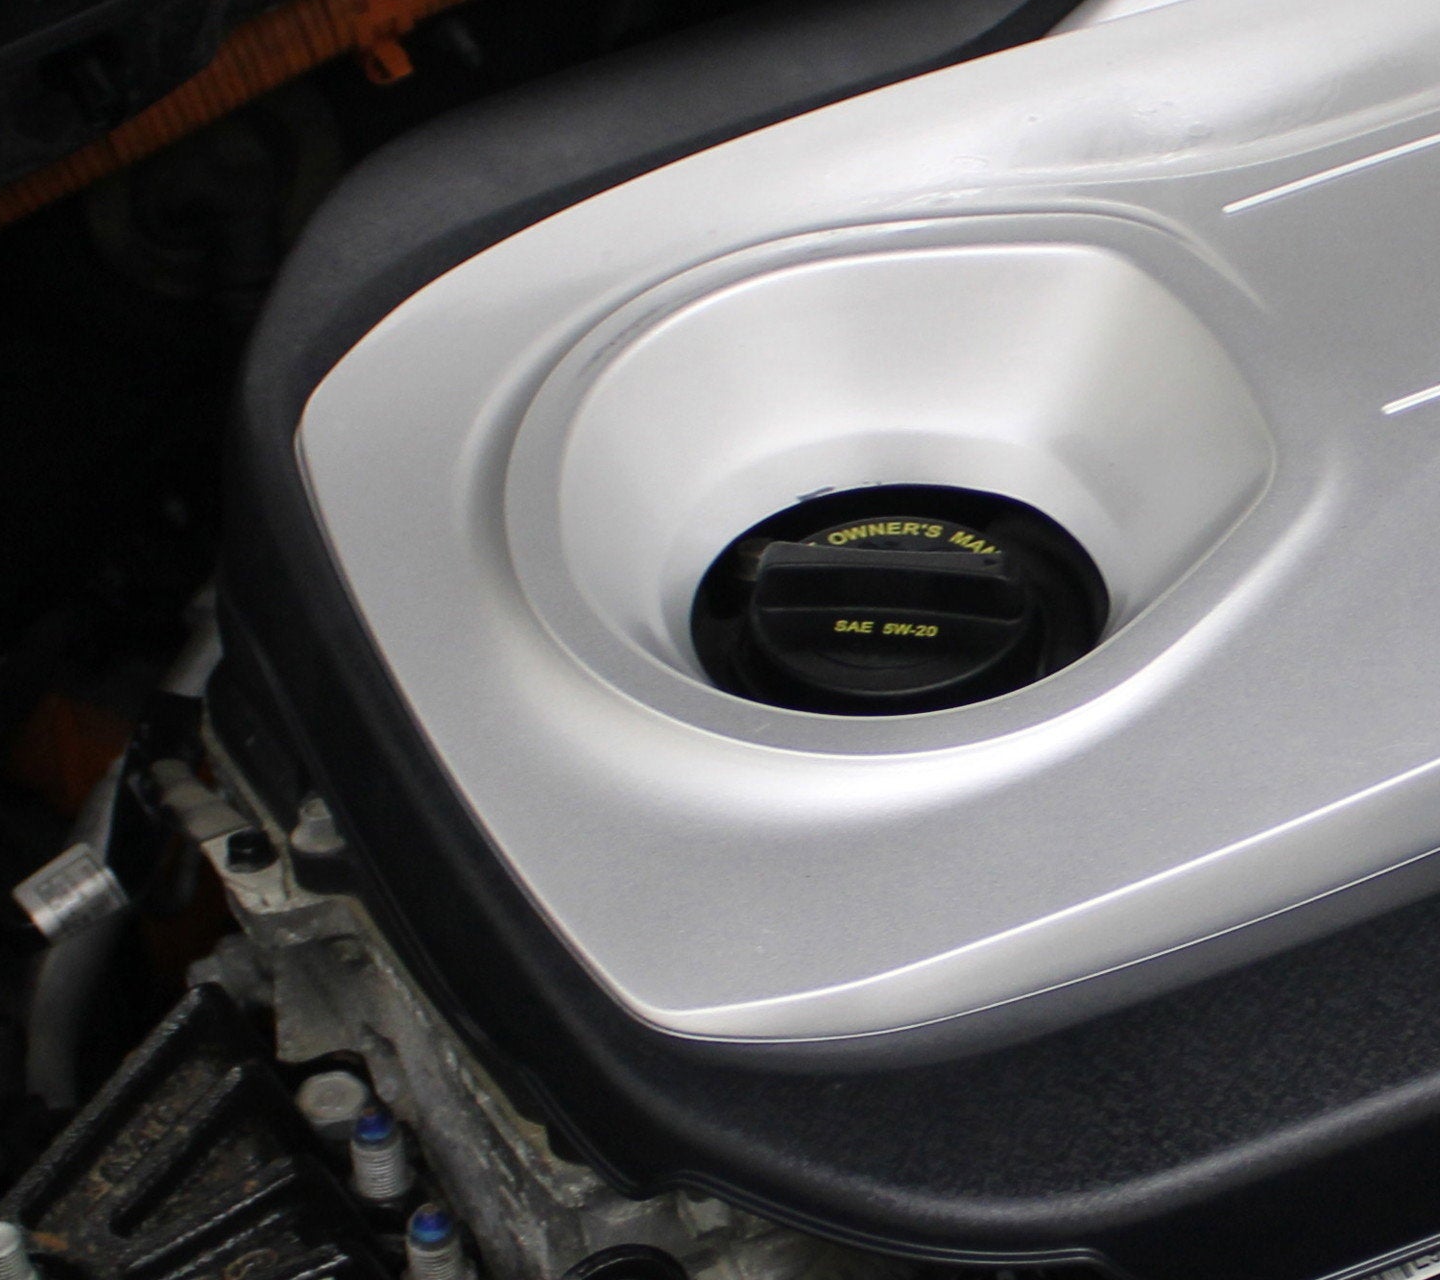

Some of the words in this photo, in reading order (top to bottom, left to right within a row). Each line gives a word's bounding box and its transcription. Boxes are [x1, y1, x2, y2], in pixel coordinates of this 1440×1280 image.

[827, 522, 943, 546] OWNER'S
[833, 619, 873, 635] SAE
[882, 622, 939, 638] 5W-20
